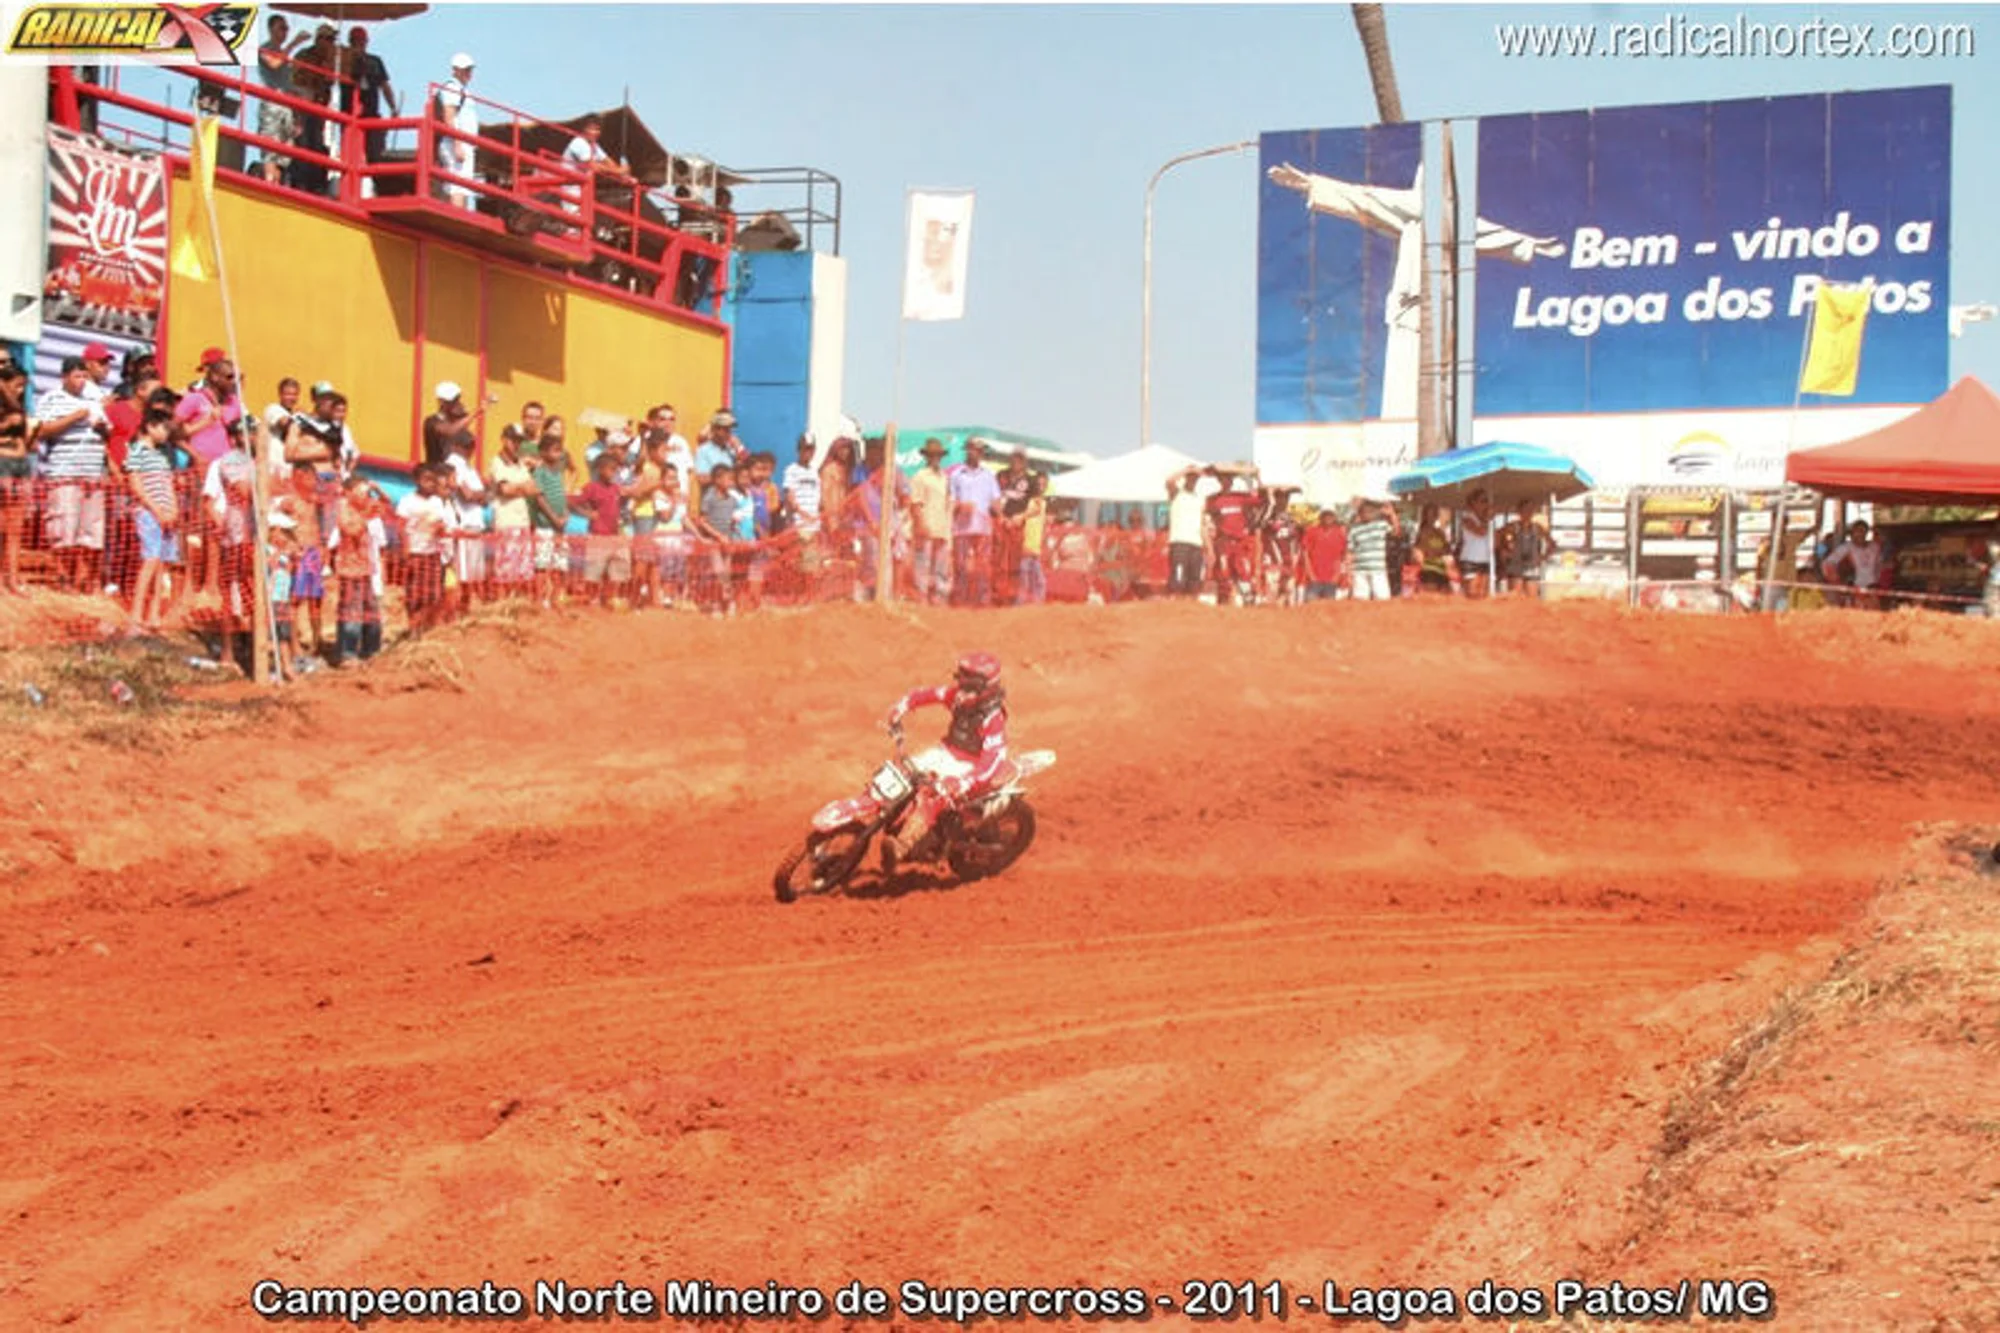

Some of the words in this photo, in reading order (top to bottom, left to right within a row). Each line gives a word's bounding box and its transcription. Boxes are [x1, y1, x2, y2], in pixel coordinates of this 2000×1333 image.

[1569, 226, 1679, 269] Bem
[1731, 210, 1880, 261] vindo
[1894, 220, 1933, 254] a
[1512, 286, 1669, 337] Lagoa
[1683, 275, 1774, 322] dos
[1788, 273, 1932, 318] Pos
